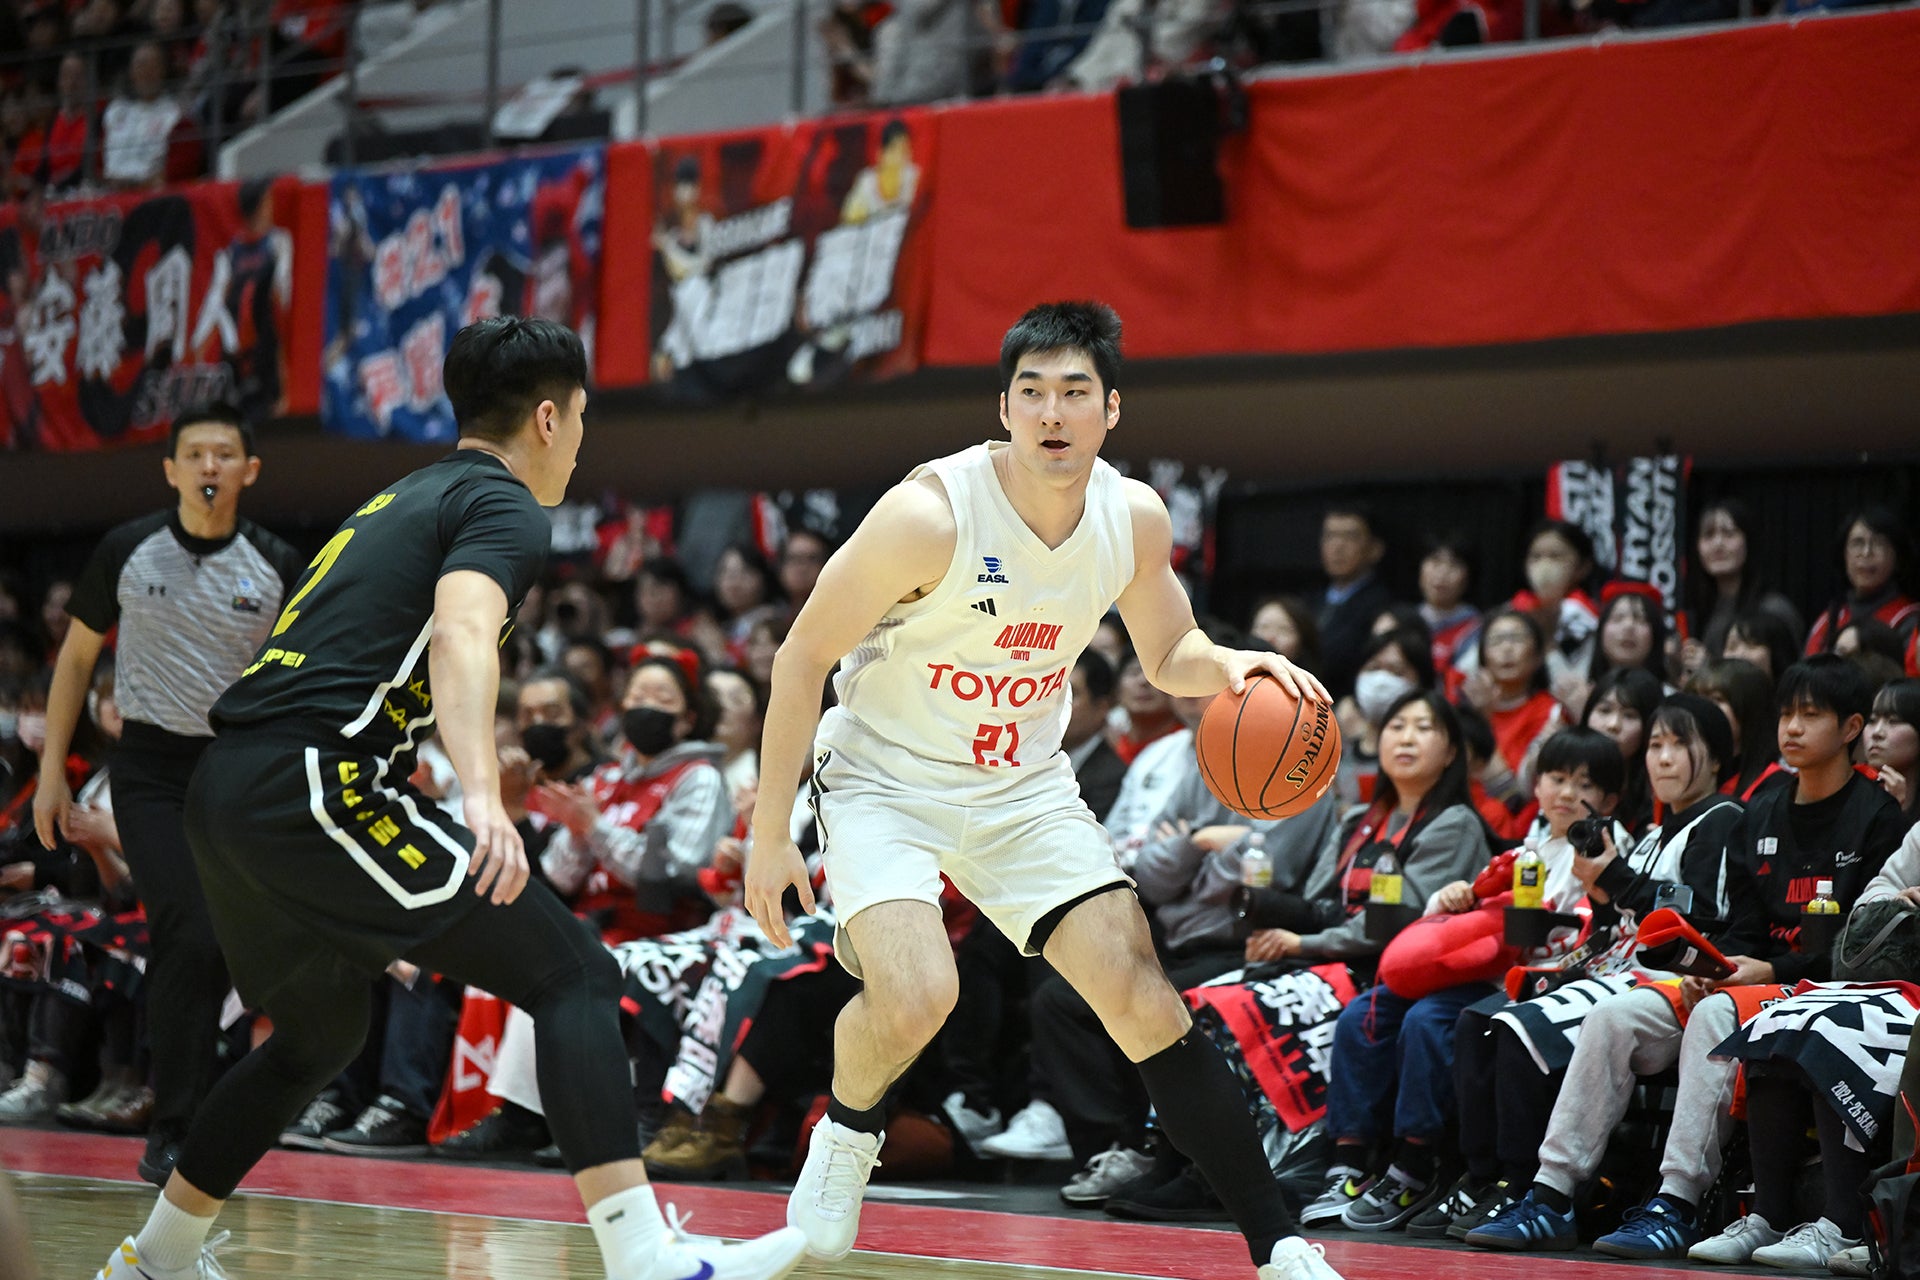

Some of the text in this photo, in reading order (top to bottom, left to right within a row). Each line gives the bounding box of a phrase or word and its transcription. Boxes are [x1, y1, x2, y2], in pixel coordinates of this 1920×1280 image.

[272, 528, 355, 637] 2
[977, 573, 1009, 584] EASL
[993, 622, 1064, 651] ALVARK
[1010, 650, 1031, 662] TOKYO
[927, 662, 1067, 708] TOYOTA
[972, 721, 1021, 767] 21
[1286, 701, 1329, 790] SPALDING
[1831, 1080, 1866, 1118] 2024-25
